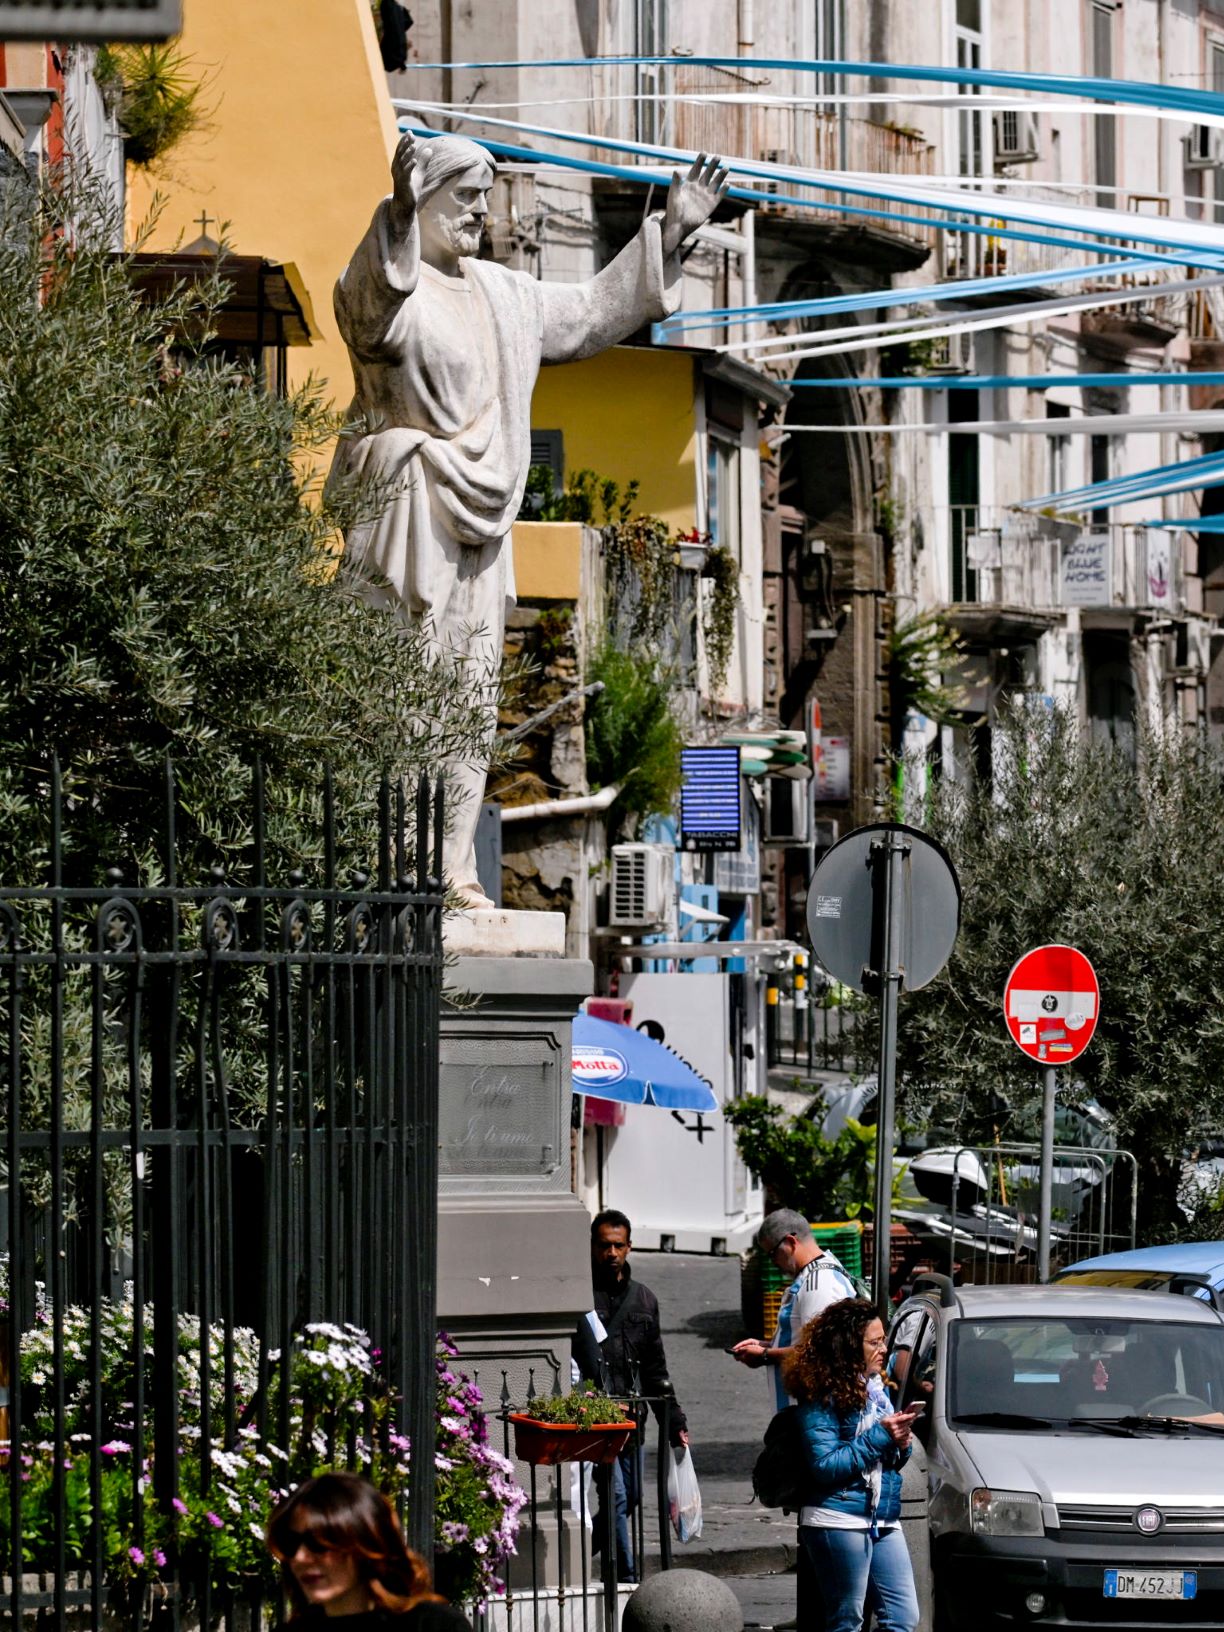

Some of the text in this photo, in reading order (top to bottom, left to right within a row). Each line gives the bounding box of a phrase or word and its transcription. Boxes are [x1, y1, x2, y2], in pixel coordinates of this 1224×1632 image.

[1067, 557, 1102, 570] BLUE
[1065, 570, 1106, 583] HOME
[685, 831, 738, 839] TABACCHI
[572, 1060, 619, 1071] Motta
